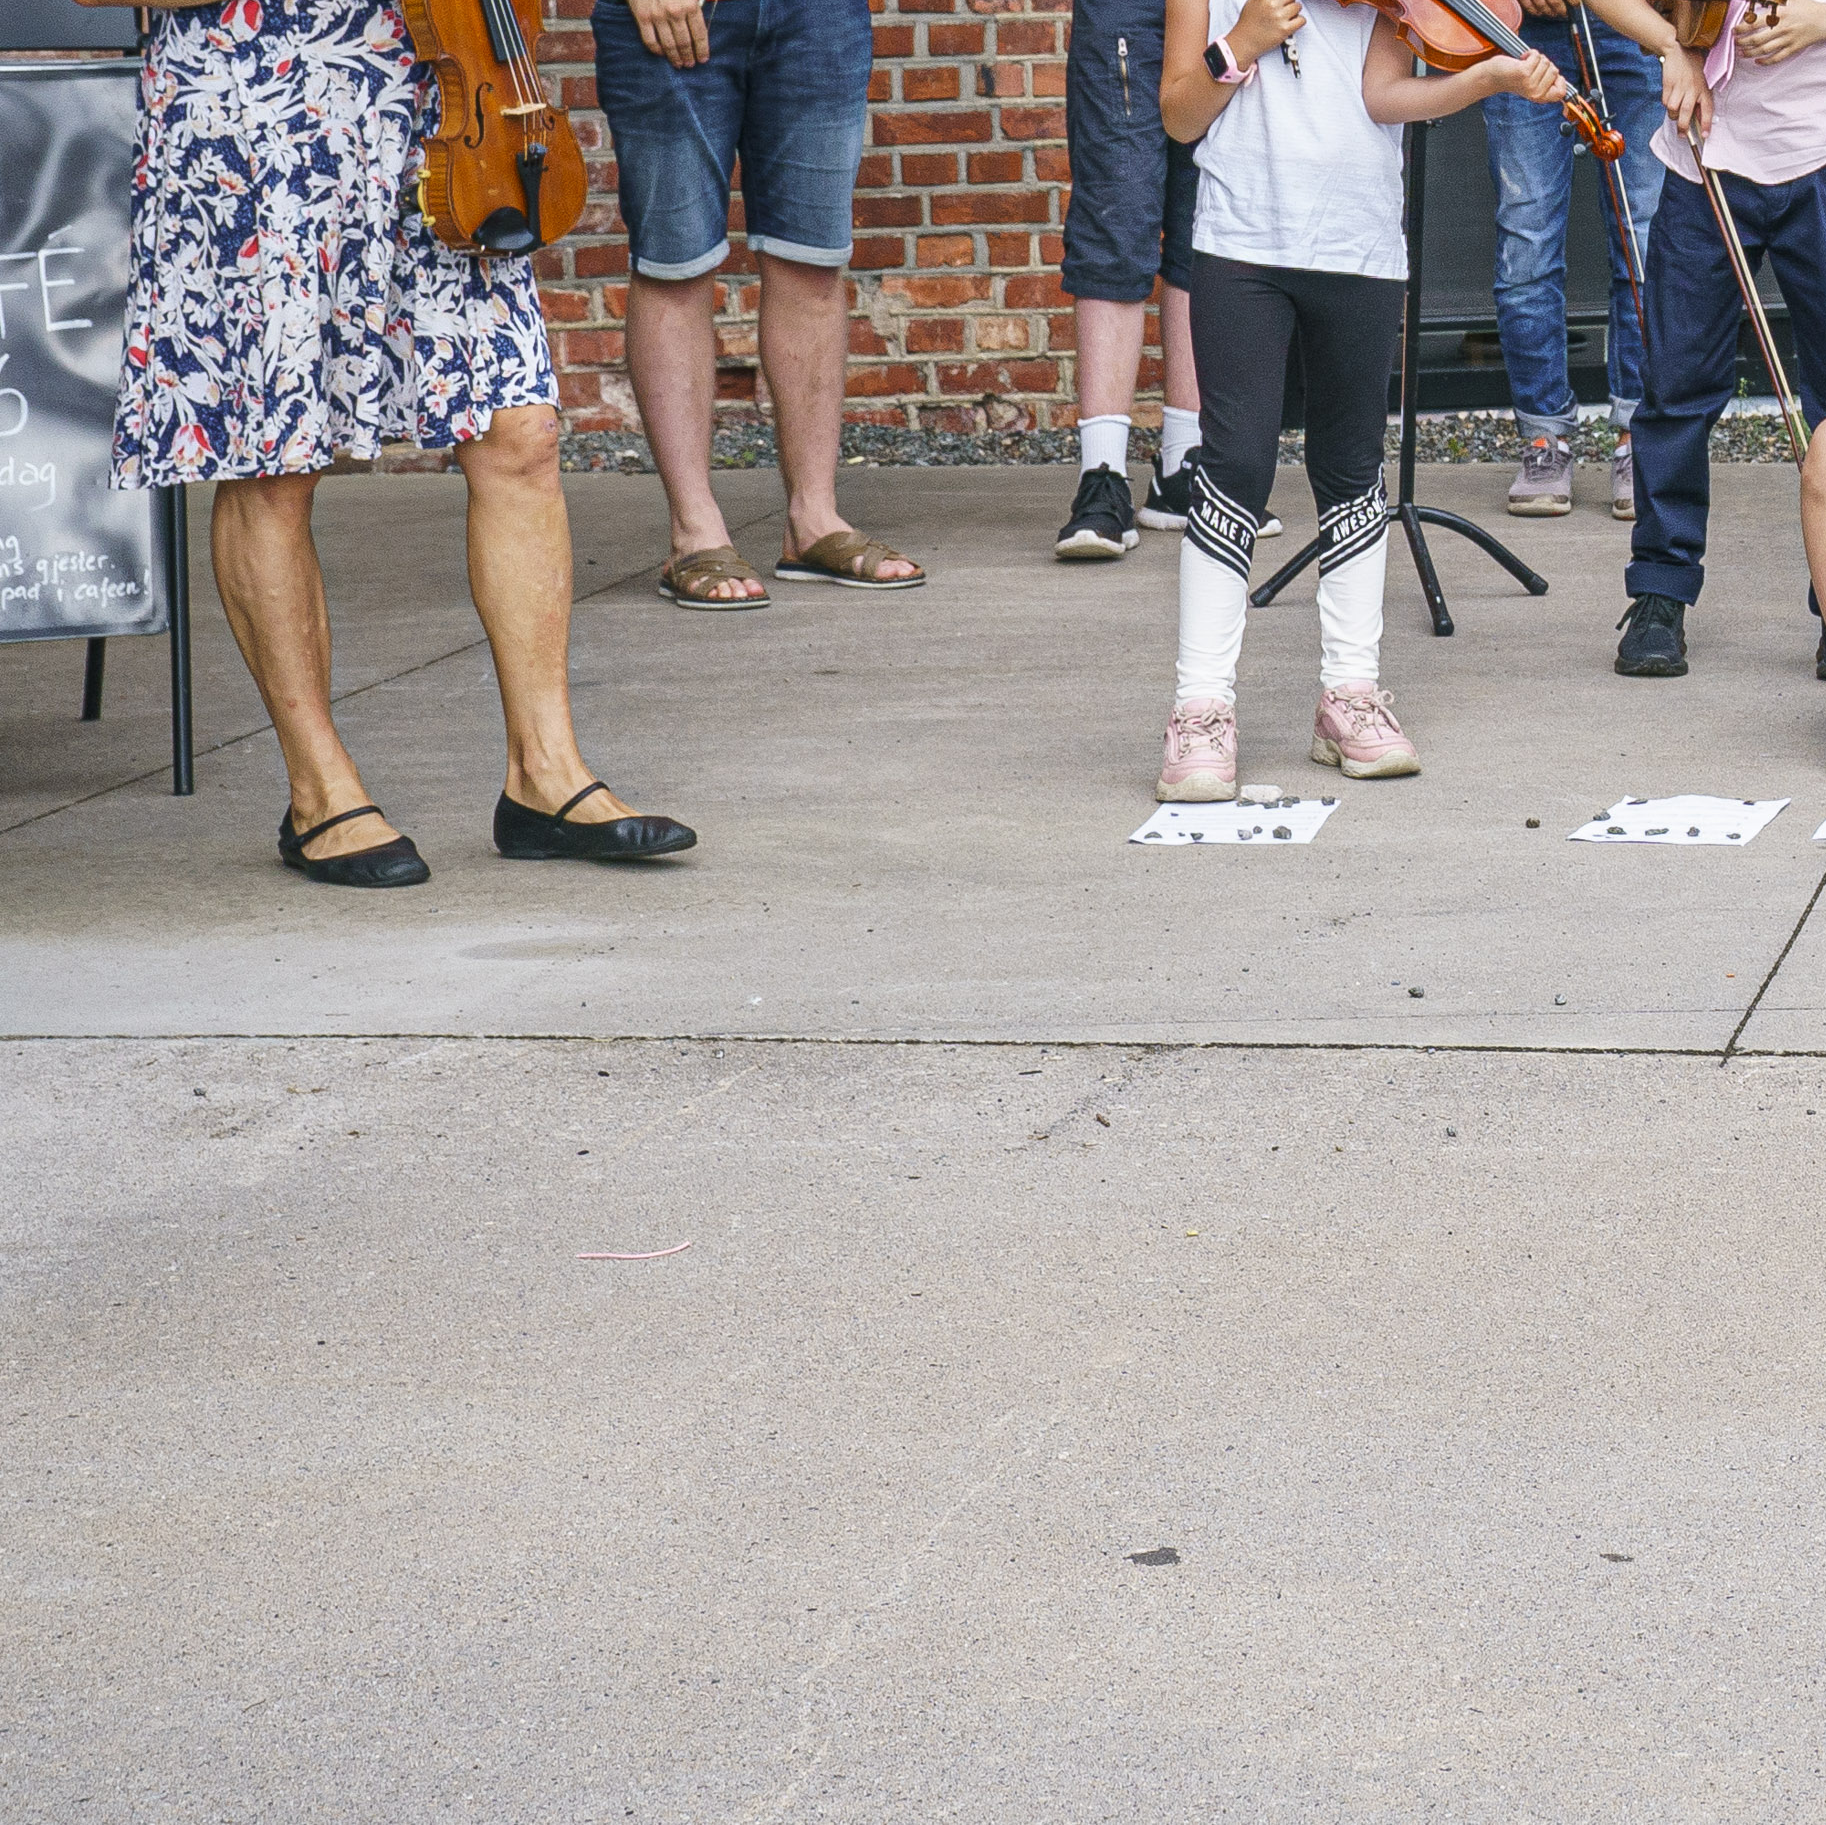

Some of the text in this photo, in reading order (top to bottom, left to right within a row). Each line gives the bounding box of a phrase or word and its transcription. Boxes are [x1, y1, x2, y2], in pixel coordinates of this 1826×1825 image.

[1200, 500, 1239, 542] MAKE
[35, 550, 116, 586] gjester.
[73, 567, 151, 608] cafeen!
